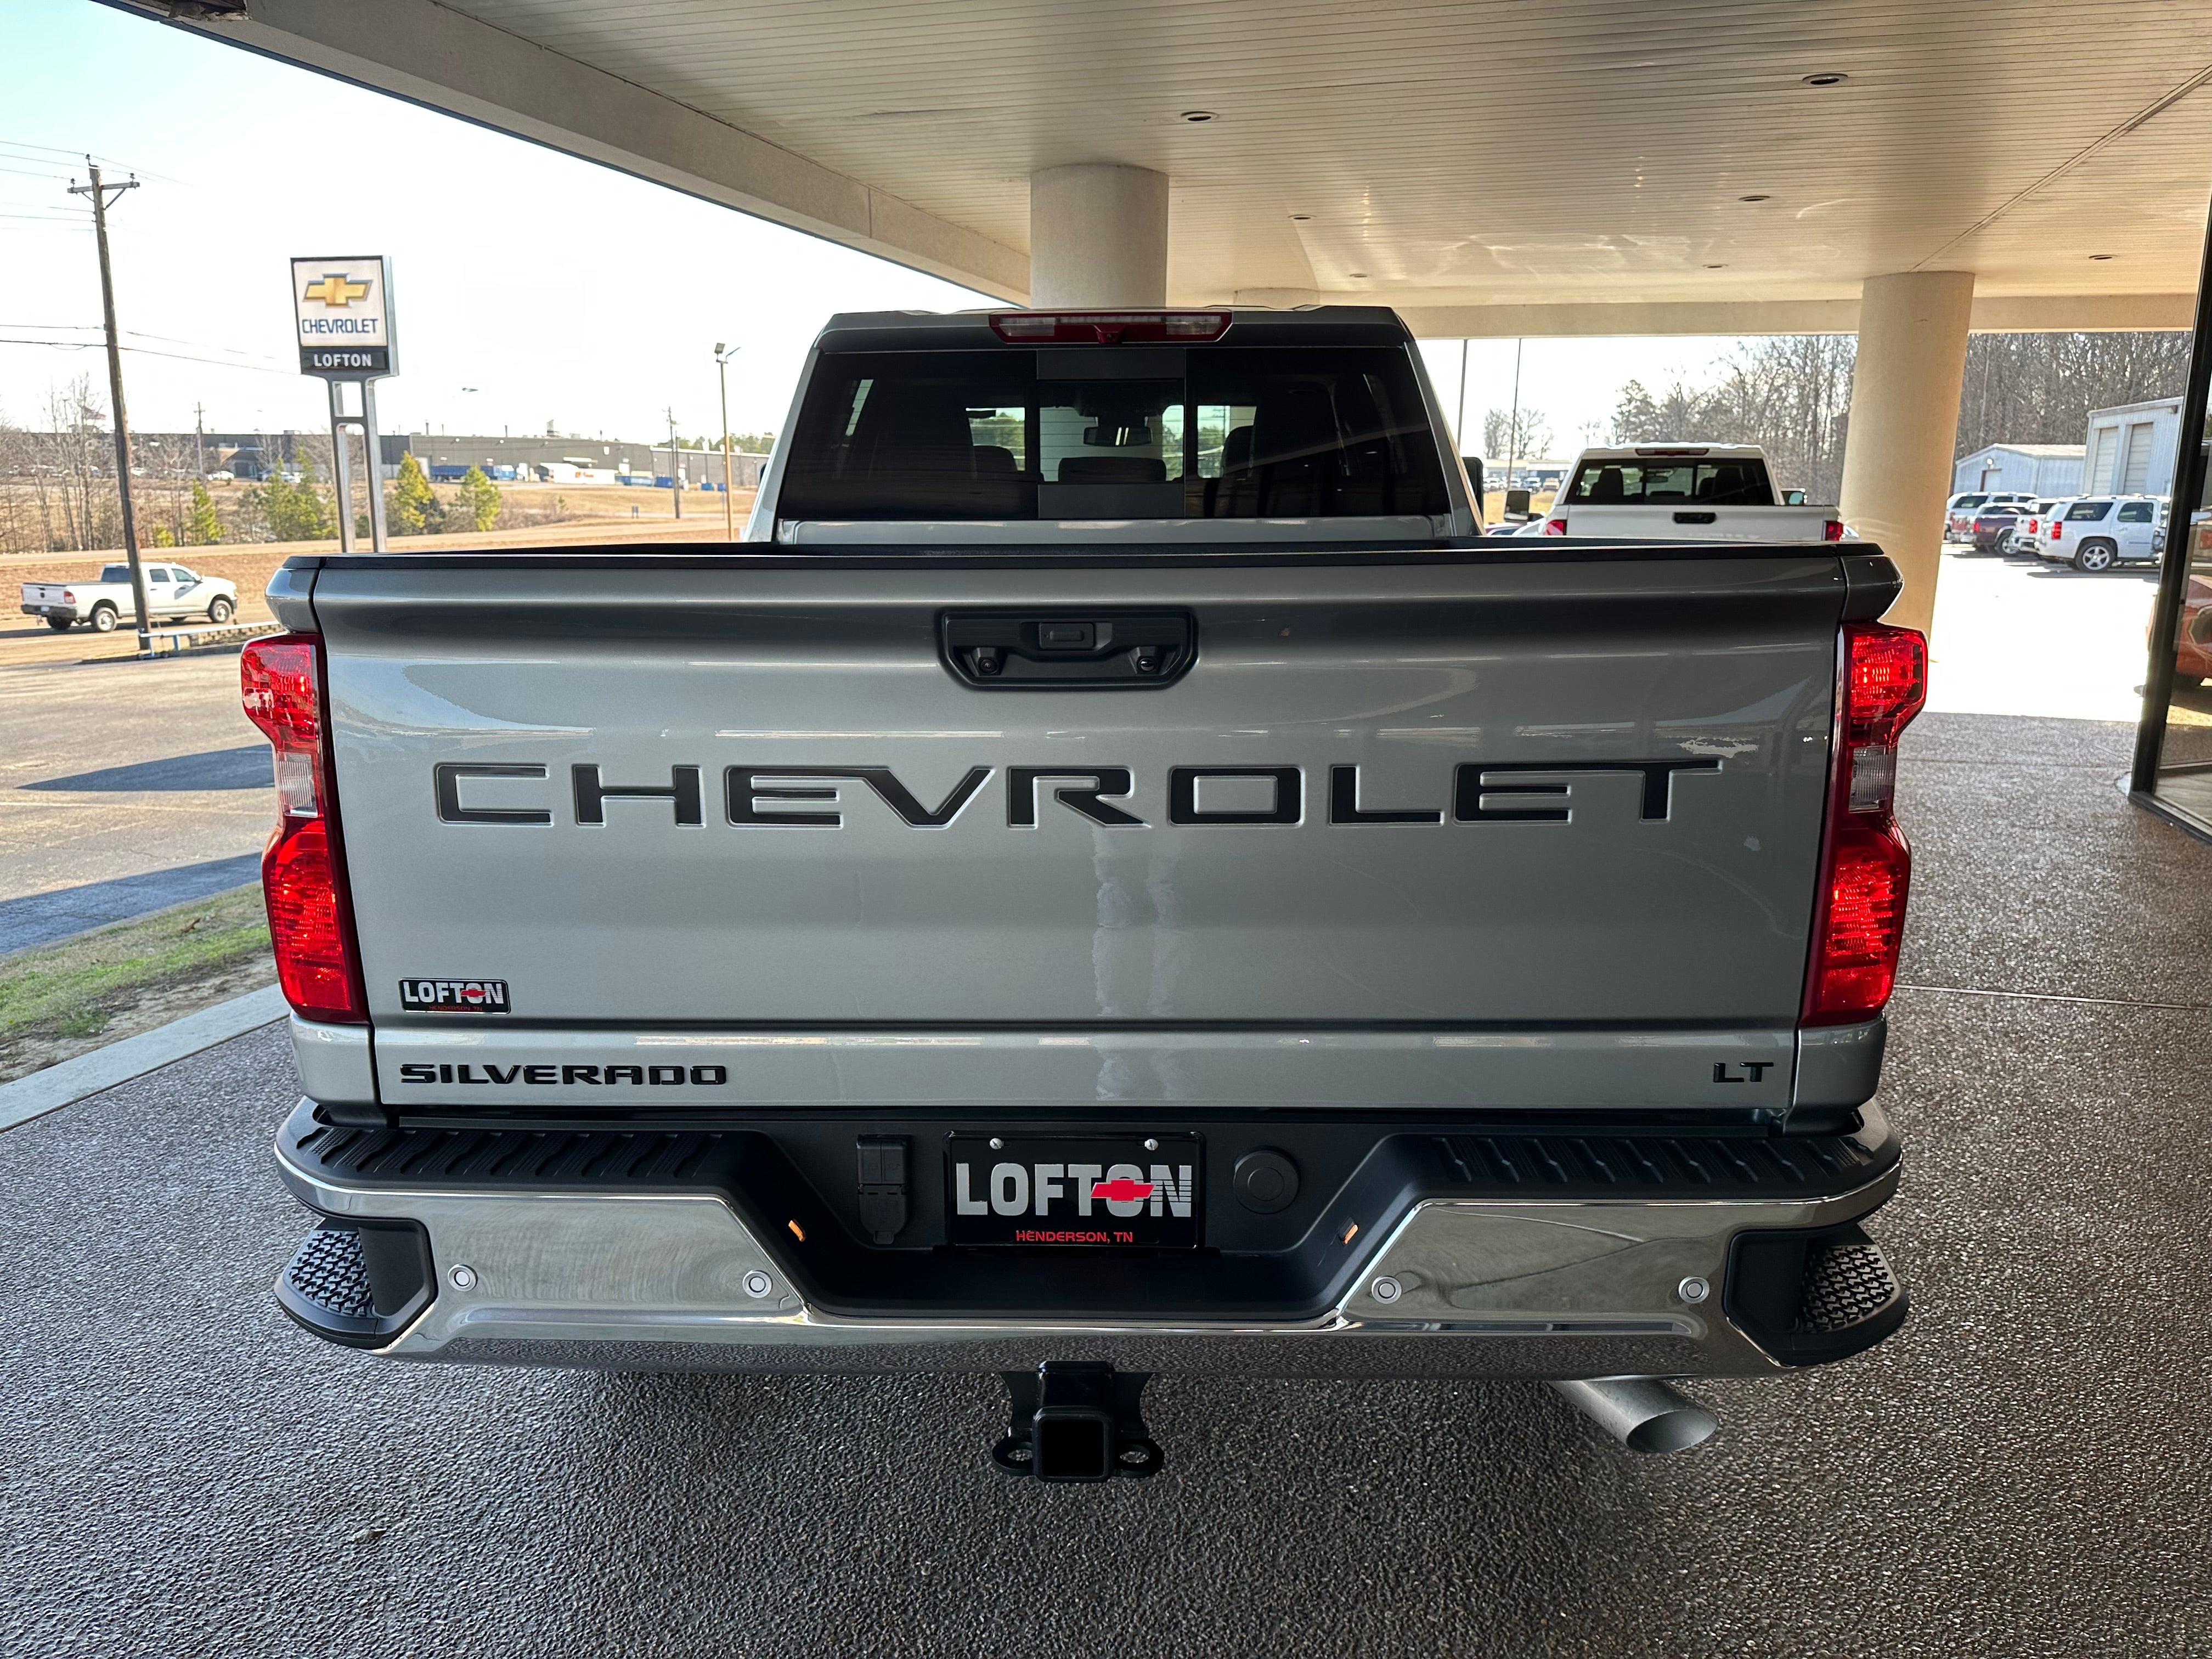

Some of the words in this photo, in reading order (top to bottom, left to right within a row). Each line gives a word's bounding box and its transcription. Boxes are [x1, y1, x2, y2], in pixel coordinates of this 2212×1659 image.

[302, 319, 378, 334] CHEVROLET
[314, 353, 372, 367] LOFTON
[434, 759, 1722, 829] CHEVROLET
[403, 981, 504, 1004] LOFTON
[400, 1064, 727, 1086] SILVERADO
[1713, 1062, 1774, 1083] LT
[956, 1163, 1192, 1217] LOFTON
[1016, 1230, 1110, 1244] HENDERSON,
[1114, 1232, 1133, 1243] TN
